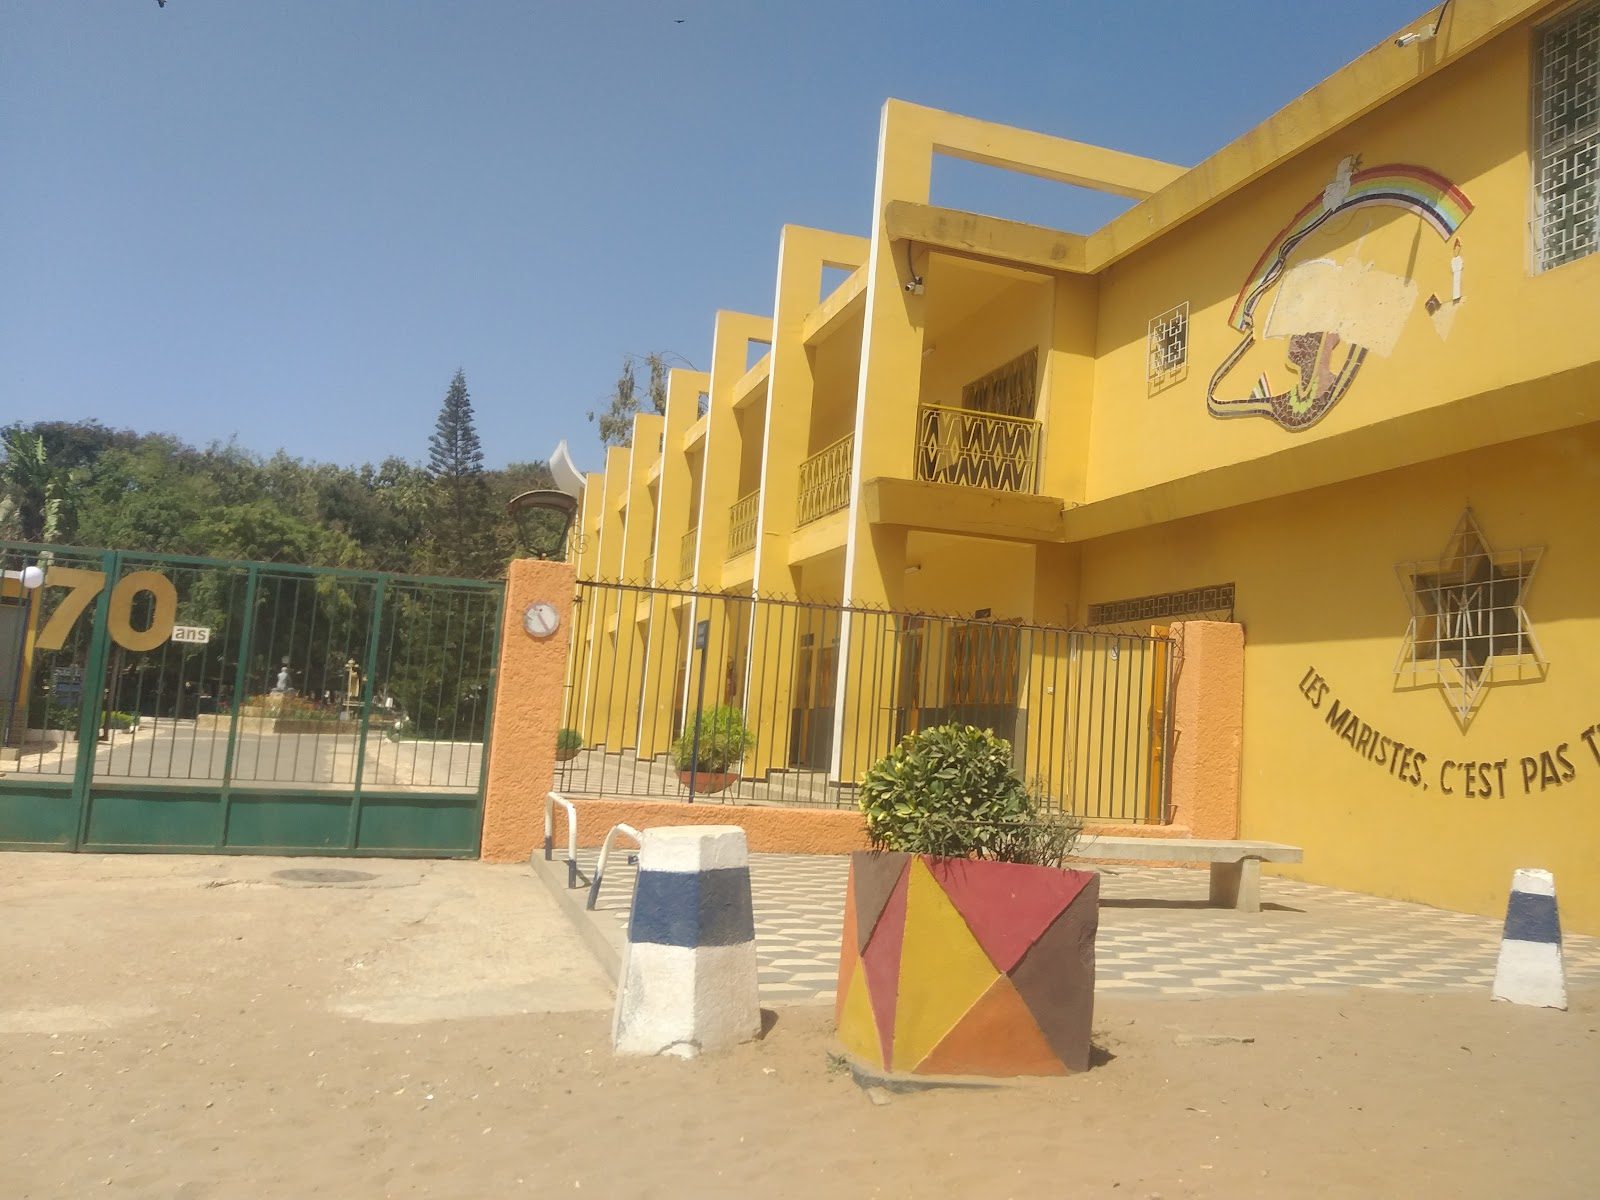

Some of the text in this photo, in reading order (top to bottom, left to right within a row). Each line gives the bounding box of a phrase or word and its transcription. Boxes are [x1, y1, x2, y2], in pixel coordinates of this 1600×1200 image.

[35, 566, 206, 652] 70 ans
[1298, 665, 1600, 799] LES MARISTES, C'EST PAS T
